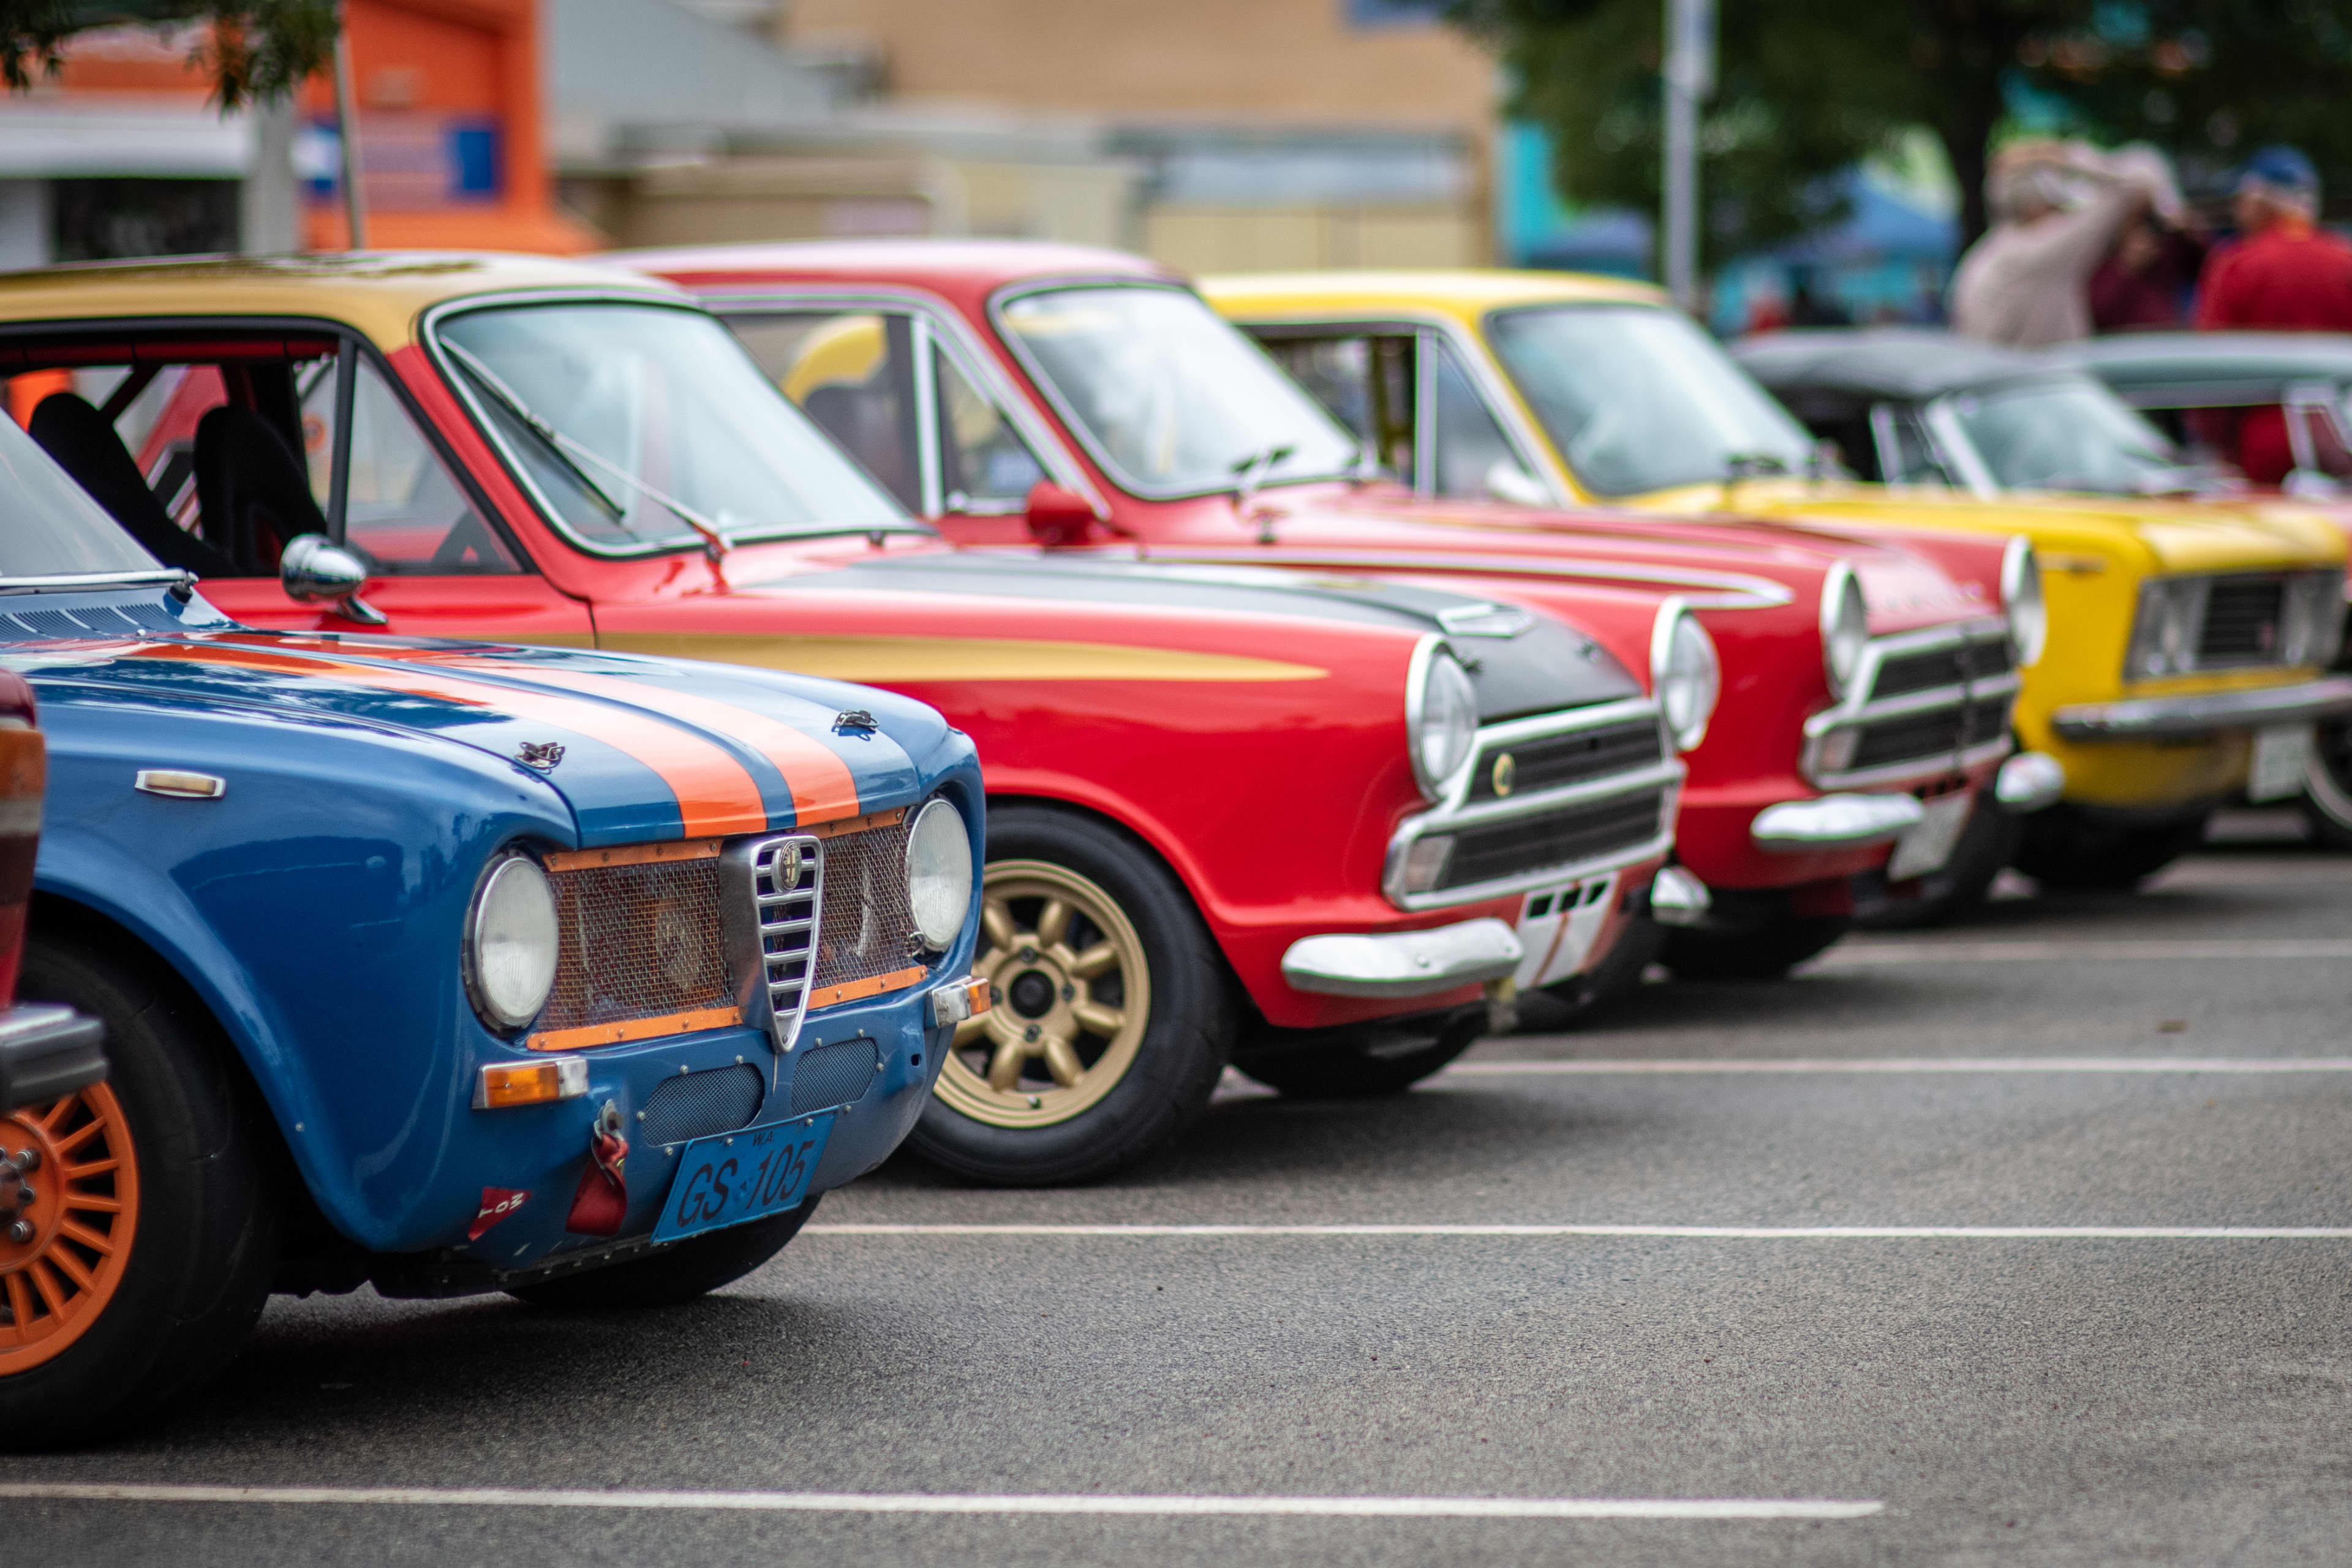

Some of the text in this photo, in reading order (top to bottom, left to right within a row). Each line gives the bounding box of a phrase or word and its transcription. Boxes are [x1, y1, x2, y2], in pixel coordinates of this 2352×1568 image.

[478, 1192, 524, 1219] TOW
[677, 1140, 815, 1227] GS 105
